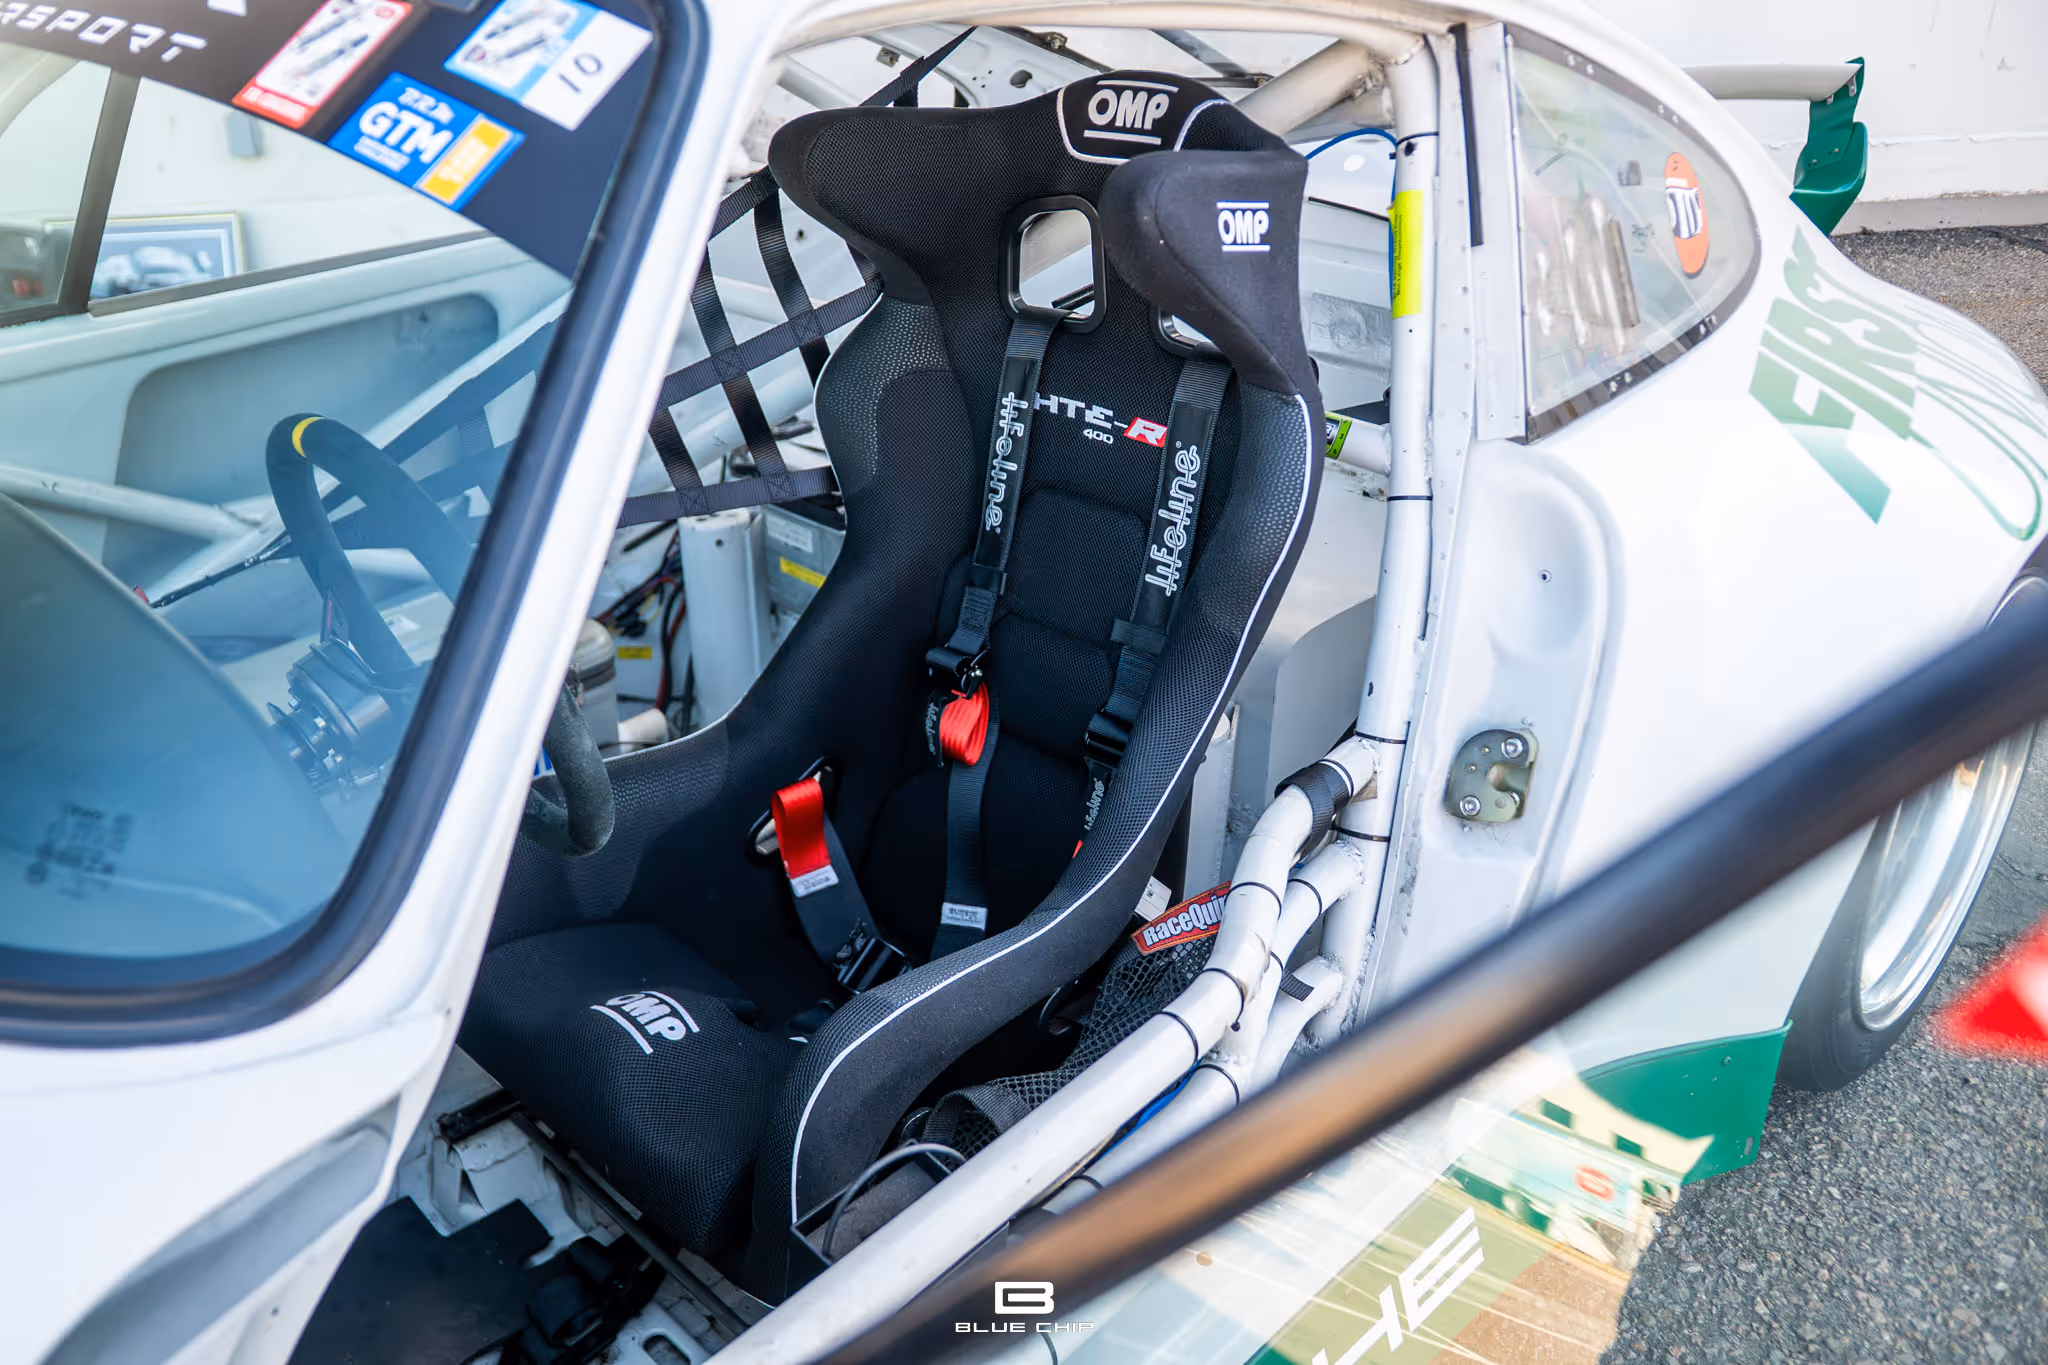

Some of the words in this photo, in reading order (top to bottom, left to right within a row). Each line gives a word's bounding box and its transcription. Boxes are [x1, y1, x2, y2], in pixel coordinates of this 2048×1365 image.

[558, 53, 603, 95] 10
[1088, 88, 1170, 130] OMP
[359, 101, 455, 164] GTM
[1217, 210, 1270, 245] OMP
[1083, 428, 1114, 444] 400
[605, 993, 687, 1041] OMP
